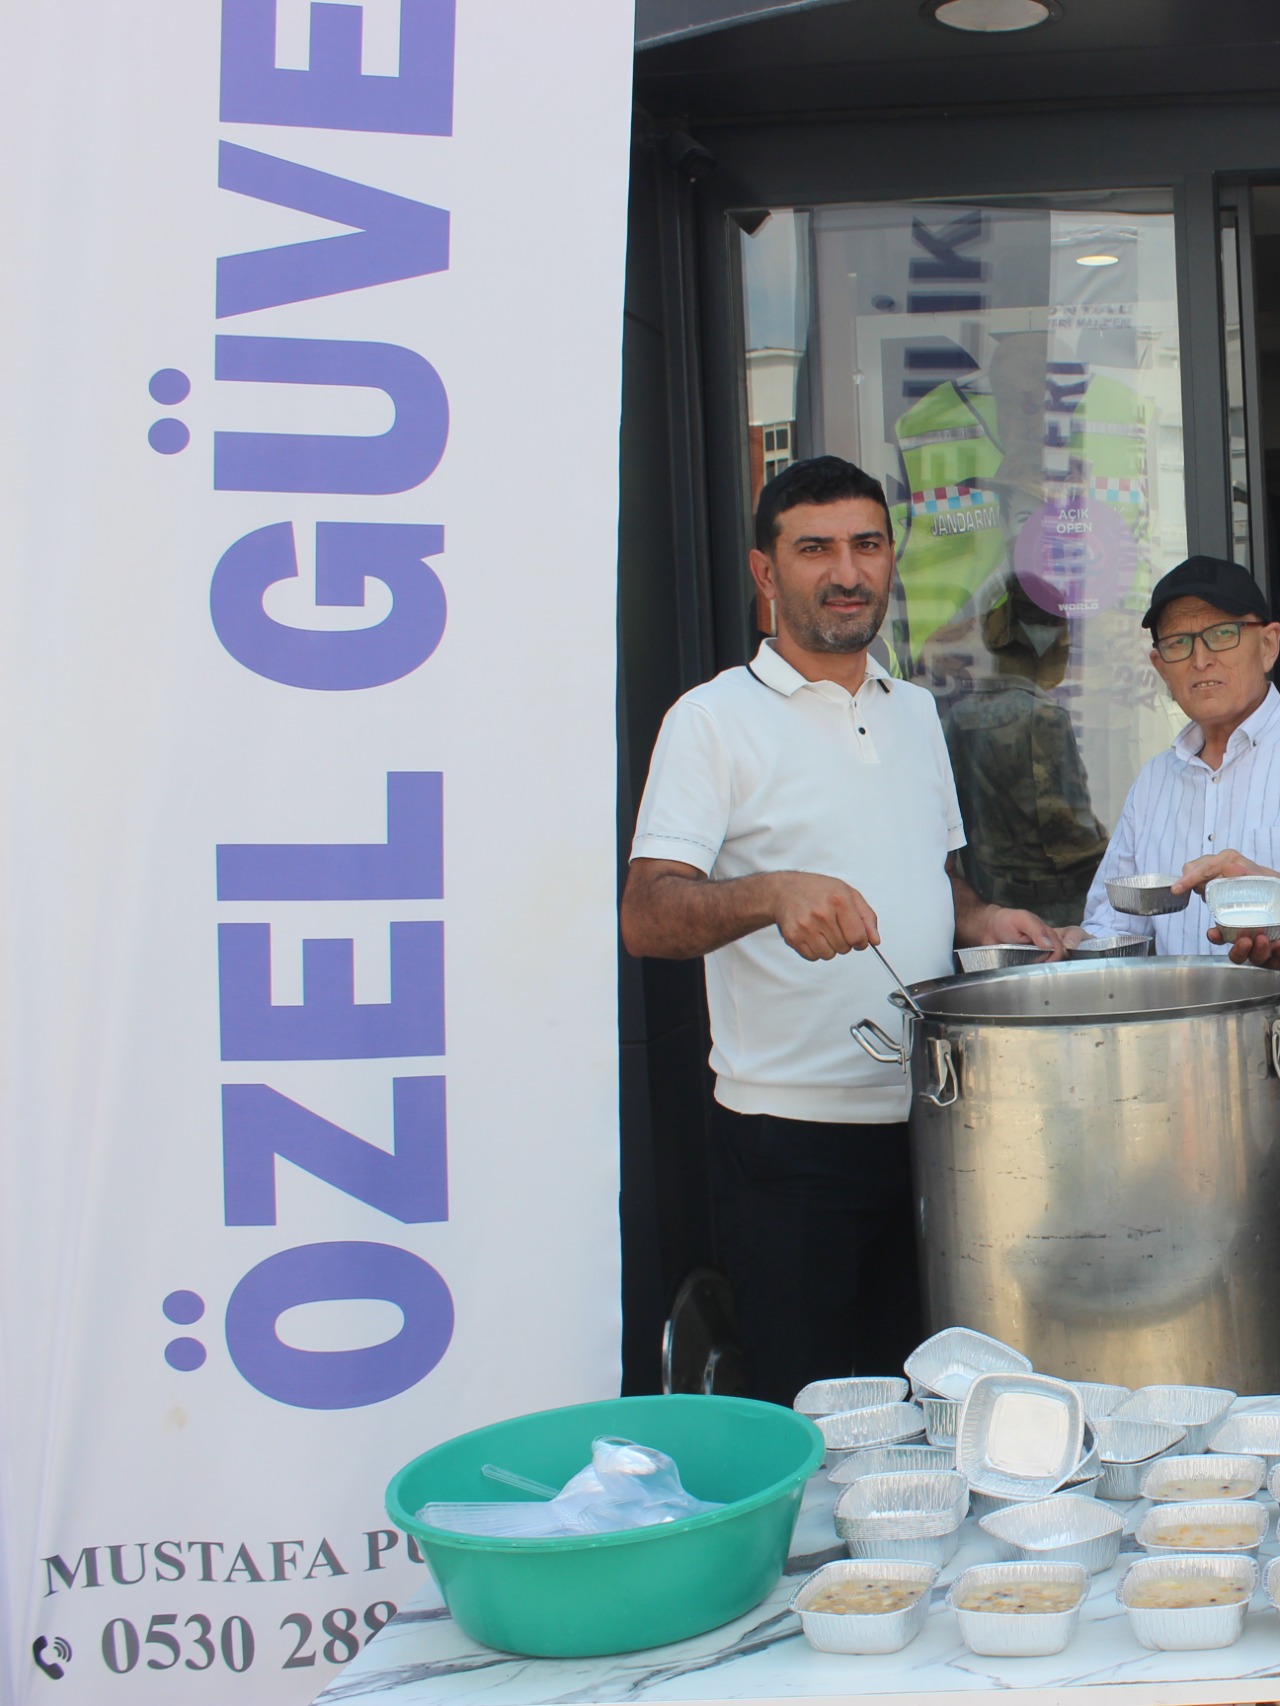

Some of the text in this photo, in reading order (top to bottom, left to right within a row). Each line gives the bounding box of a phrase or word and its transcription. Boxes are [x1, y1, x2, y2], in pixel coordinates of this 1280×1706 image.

[1056, 522, 1093, 534] OPEN
[1058, 508, 1089, 522] AÇIK
[1057, 602, 1099, 612] WORLD
[162, 771, 456, 1410] ÖZEL
[41, 1536, 349, 1599] MUSTAFA
[101, 1612, 256, 1675] 0530
